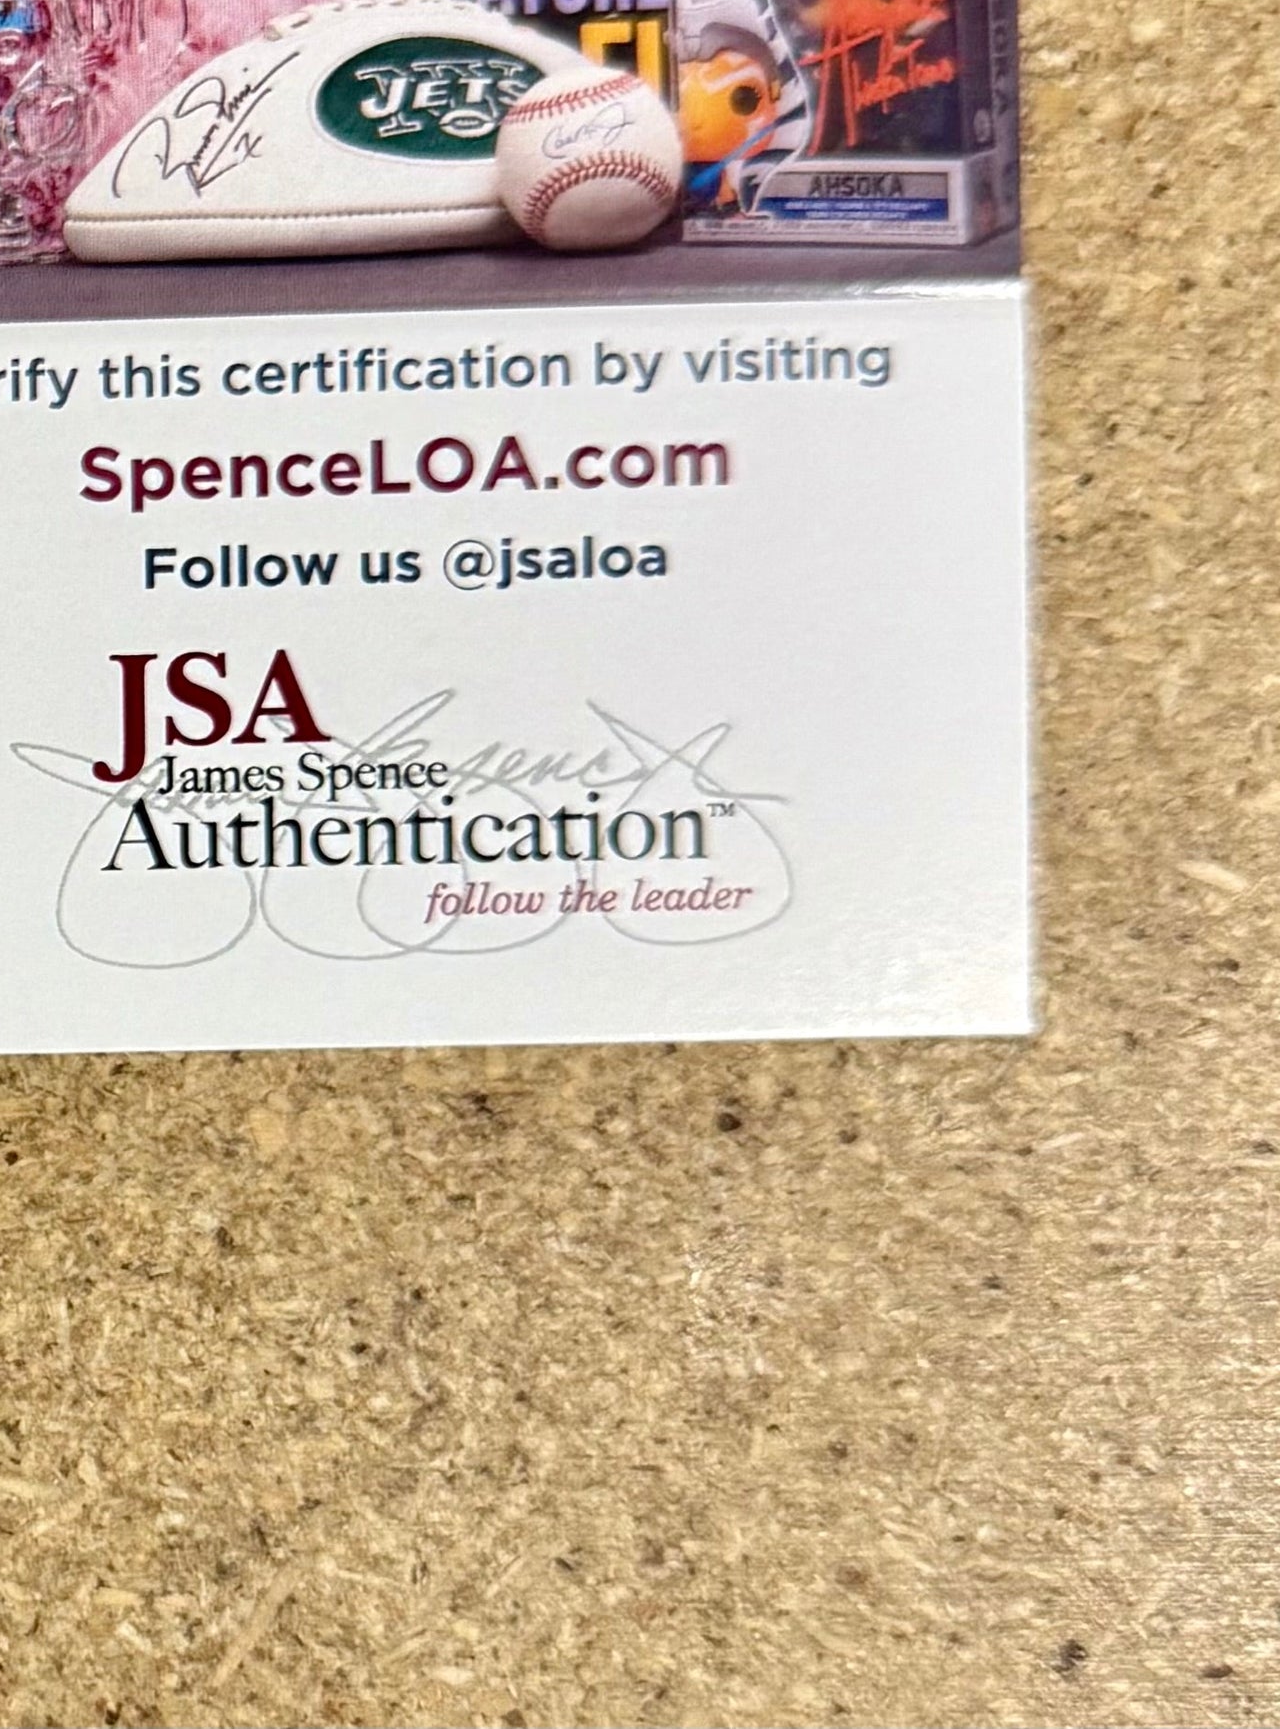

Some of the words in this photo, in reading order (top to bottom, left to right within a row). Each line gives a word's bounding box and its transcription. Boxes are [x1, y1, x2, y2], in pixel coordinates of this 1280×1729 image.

[808, 175, 904, 197] AHSOKA
[98, 353, 201, 399] this
[222, 344, 571, 396] certification
[595, 341, 664, 394] by
[683, 336, 892, 388] visiting
[79, 435, 729, 513] SpenceLOA.com
[145, 544, 339, 590] Follow
[360, 550, 422, 584] us
[443, 535, 668, 591] @jsaloa
[92, 648, 330, 785] JSA
[157, 755, 285, 796] James
[297, 753, 448, 800] Spence
[423, 881, 545, 924] follow
[559, 878, 619, 915] the
[630, 876, 754, 912] leader
